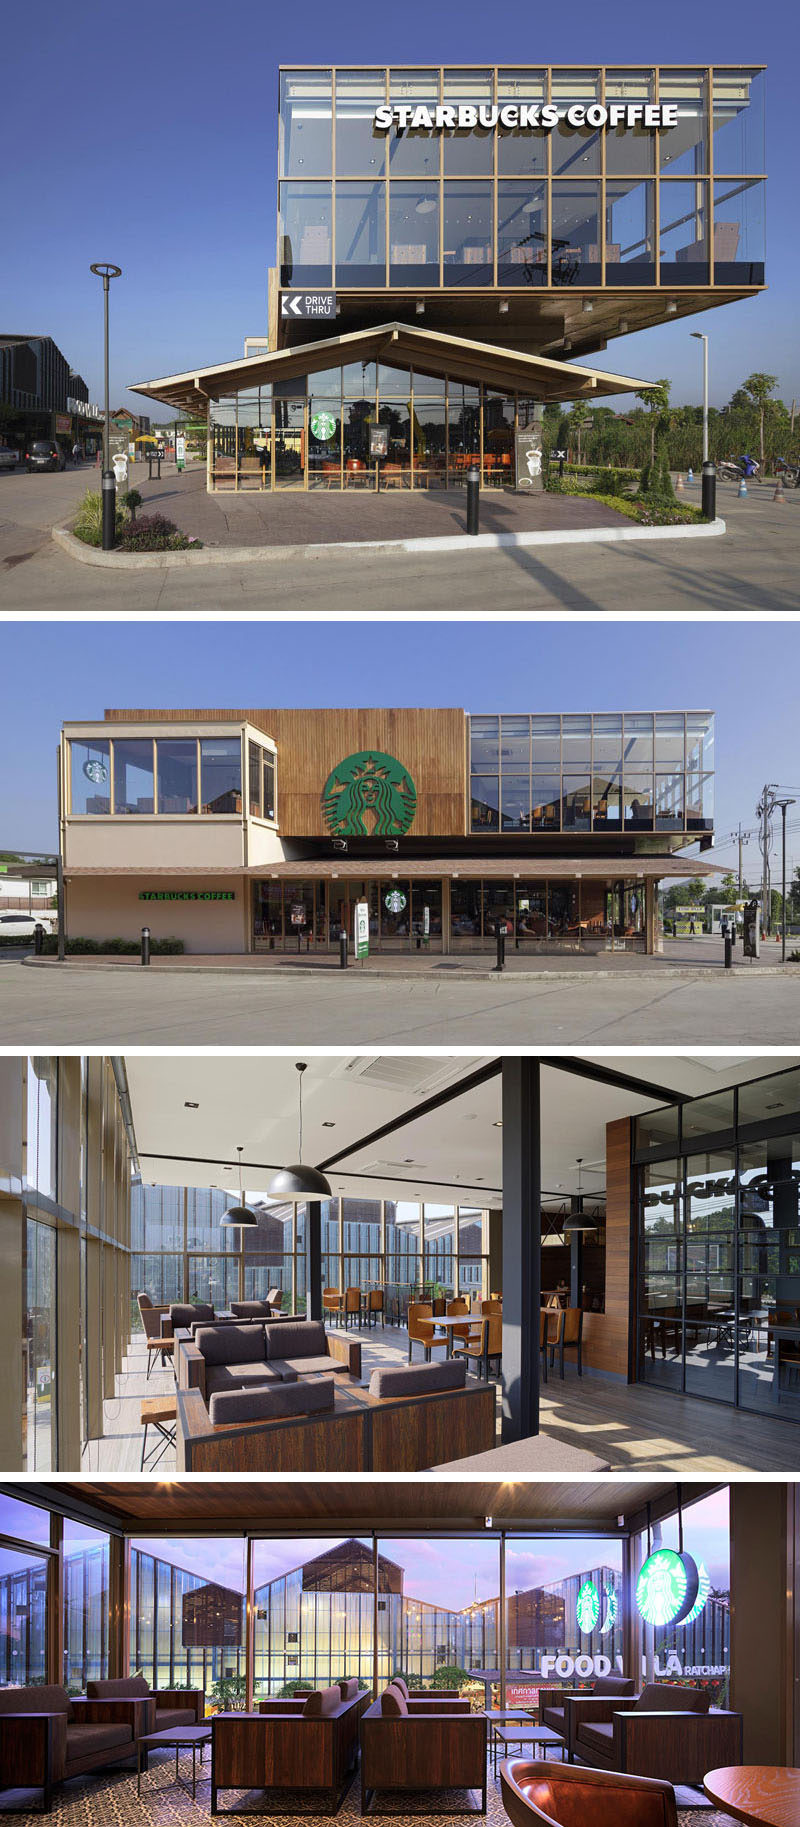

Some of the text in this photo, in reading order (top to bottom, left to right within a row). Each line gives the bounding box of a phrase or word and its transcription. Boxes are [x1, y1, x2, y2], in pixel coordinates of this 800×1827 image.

[374, 104, 678, 128] STARBUCKS COFFEE
[305, 296, 333, 305] DRIVE
[305, 306, 331, 315] THRU
[138, 891, 235, 900] STARBUCKS COFFEE
[540, 1655, 612, 1678] FOOD
